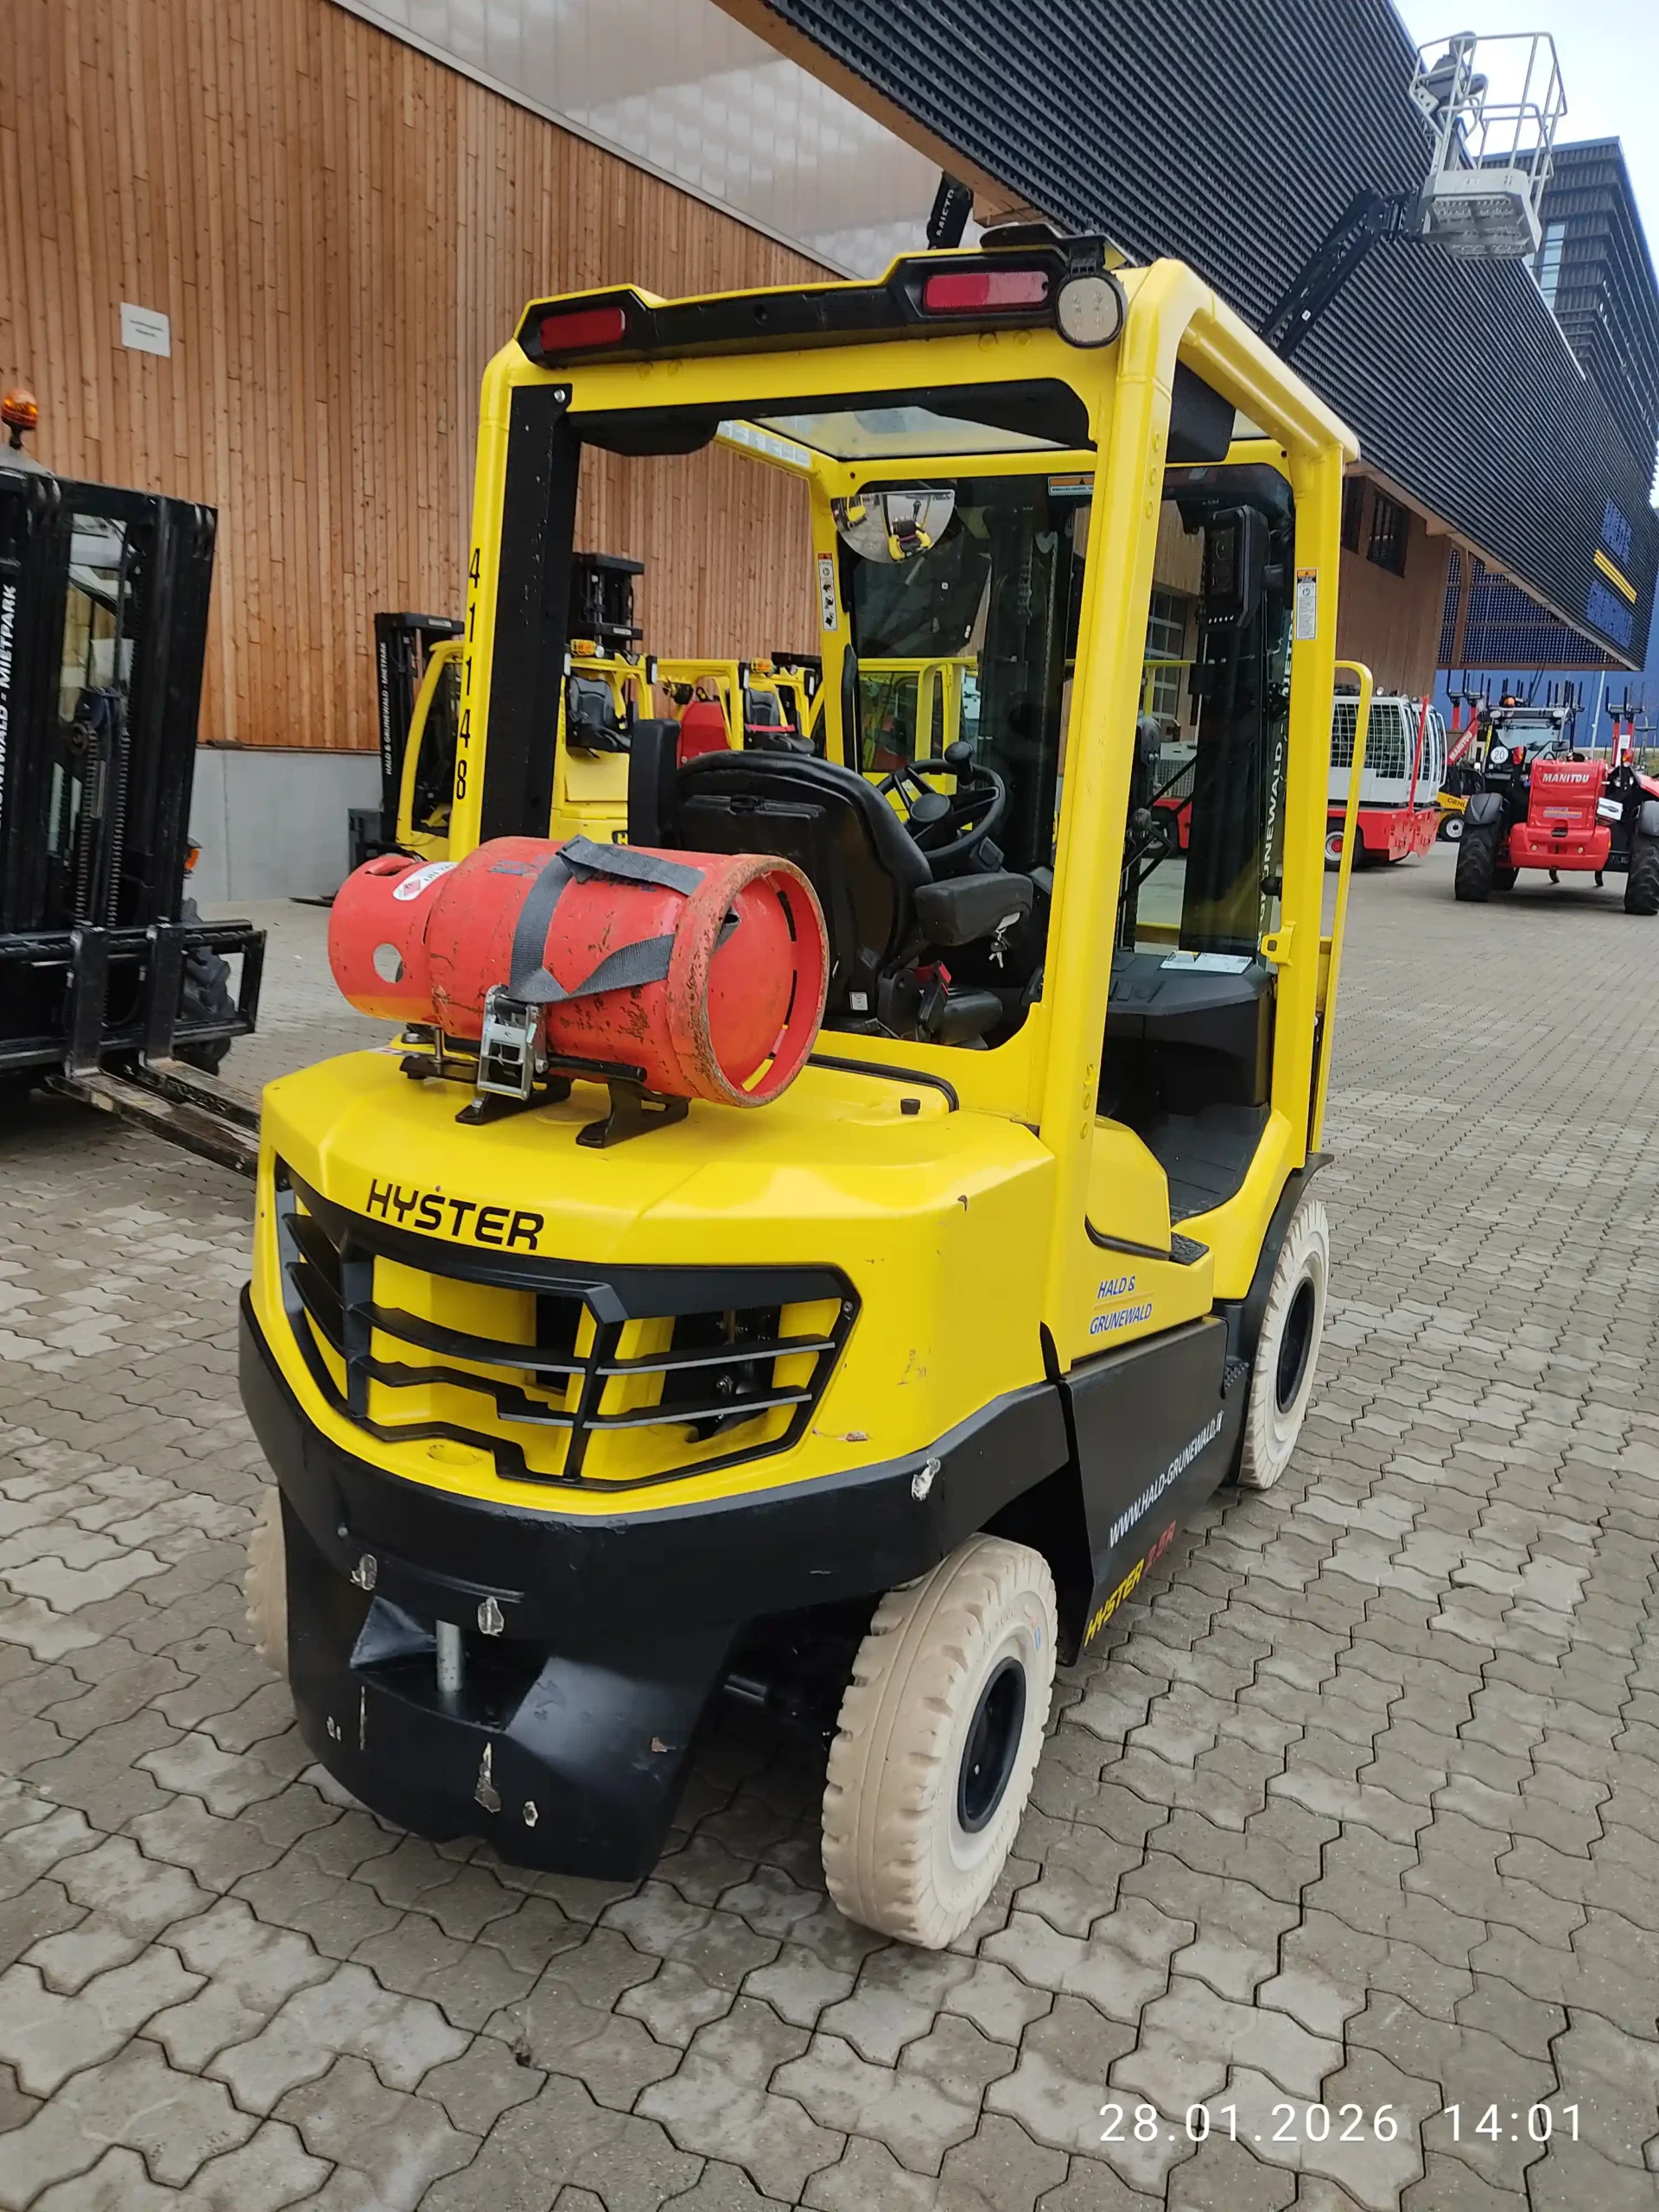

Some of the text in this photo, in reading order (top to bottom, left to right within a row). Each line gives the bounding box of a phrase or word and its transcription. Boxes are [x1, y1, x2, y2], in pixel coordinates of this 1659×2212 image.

[1449, 730, 1473, 761] MANITOU
[1494, 749, 1505, 760] 20
[1542, 772, 1590, 783] MANITOU
[366, 1178, 544, 1251] HYSTER
[1096, 1275, 1136, 1300] HALD &
[1090, 1303, 1153, 1335] GRUNEWALD
[1084, 1558, 1145, 1648] HYSTER
